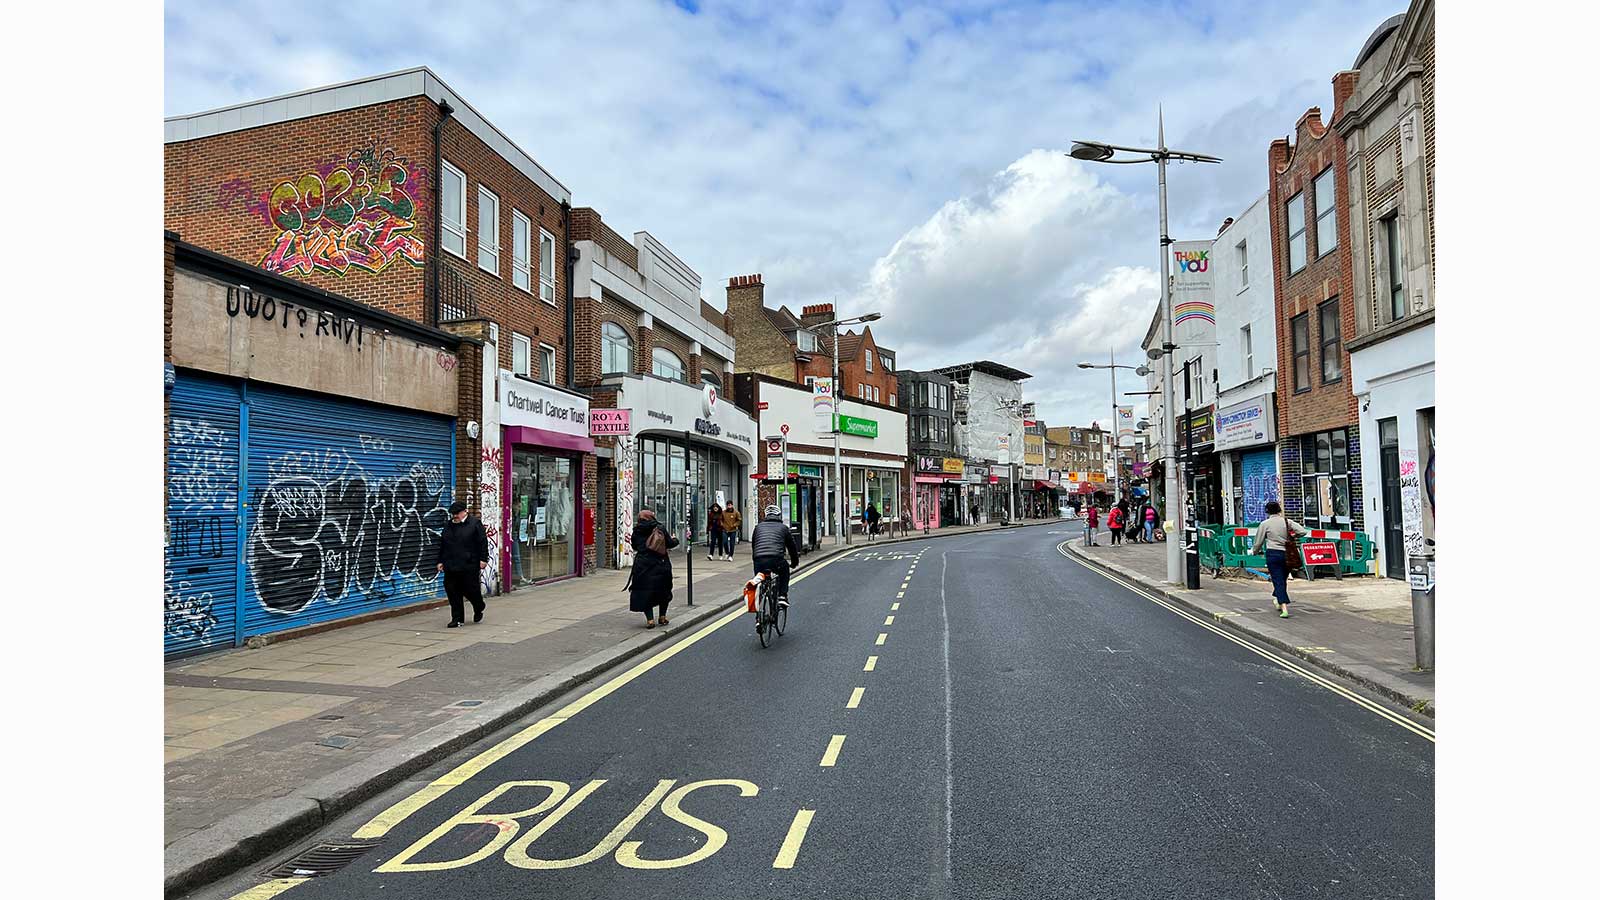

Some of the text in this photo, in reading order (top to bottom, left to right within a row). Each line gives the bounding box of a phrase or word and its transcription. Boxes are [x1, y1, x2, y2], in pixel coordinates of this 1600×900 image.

[1174, 250, 1209, 261] THANK
[1179, 259, 1209, 273] YOU
[507, 390, 586, 424] Chartwell Cancer Trust
[592, 423, 630, 432] TEXTILE
[846, 417, 877, 434] Supermarket
[371, 779, 759, 872] BUS
